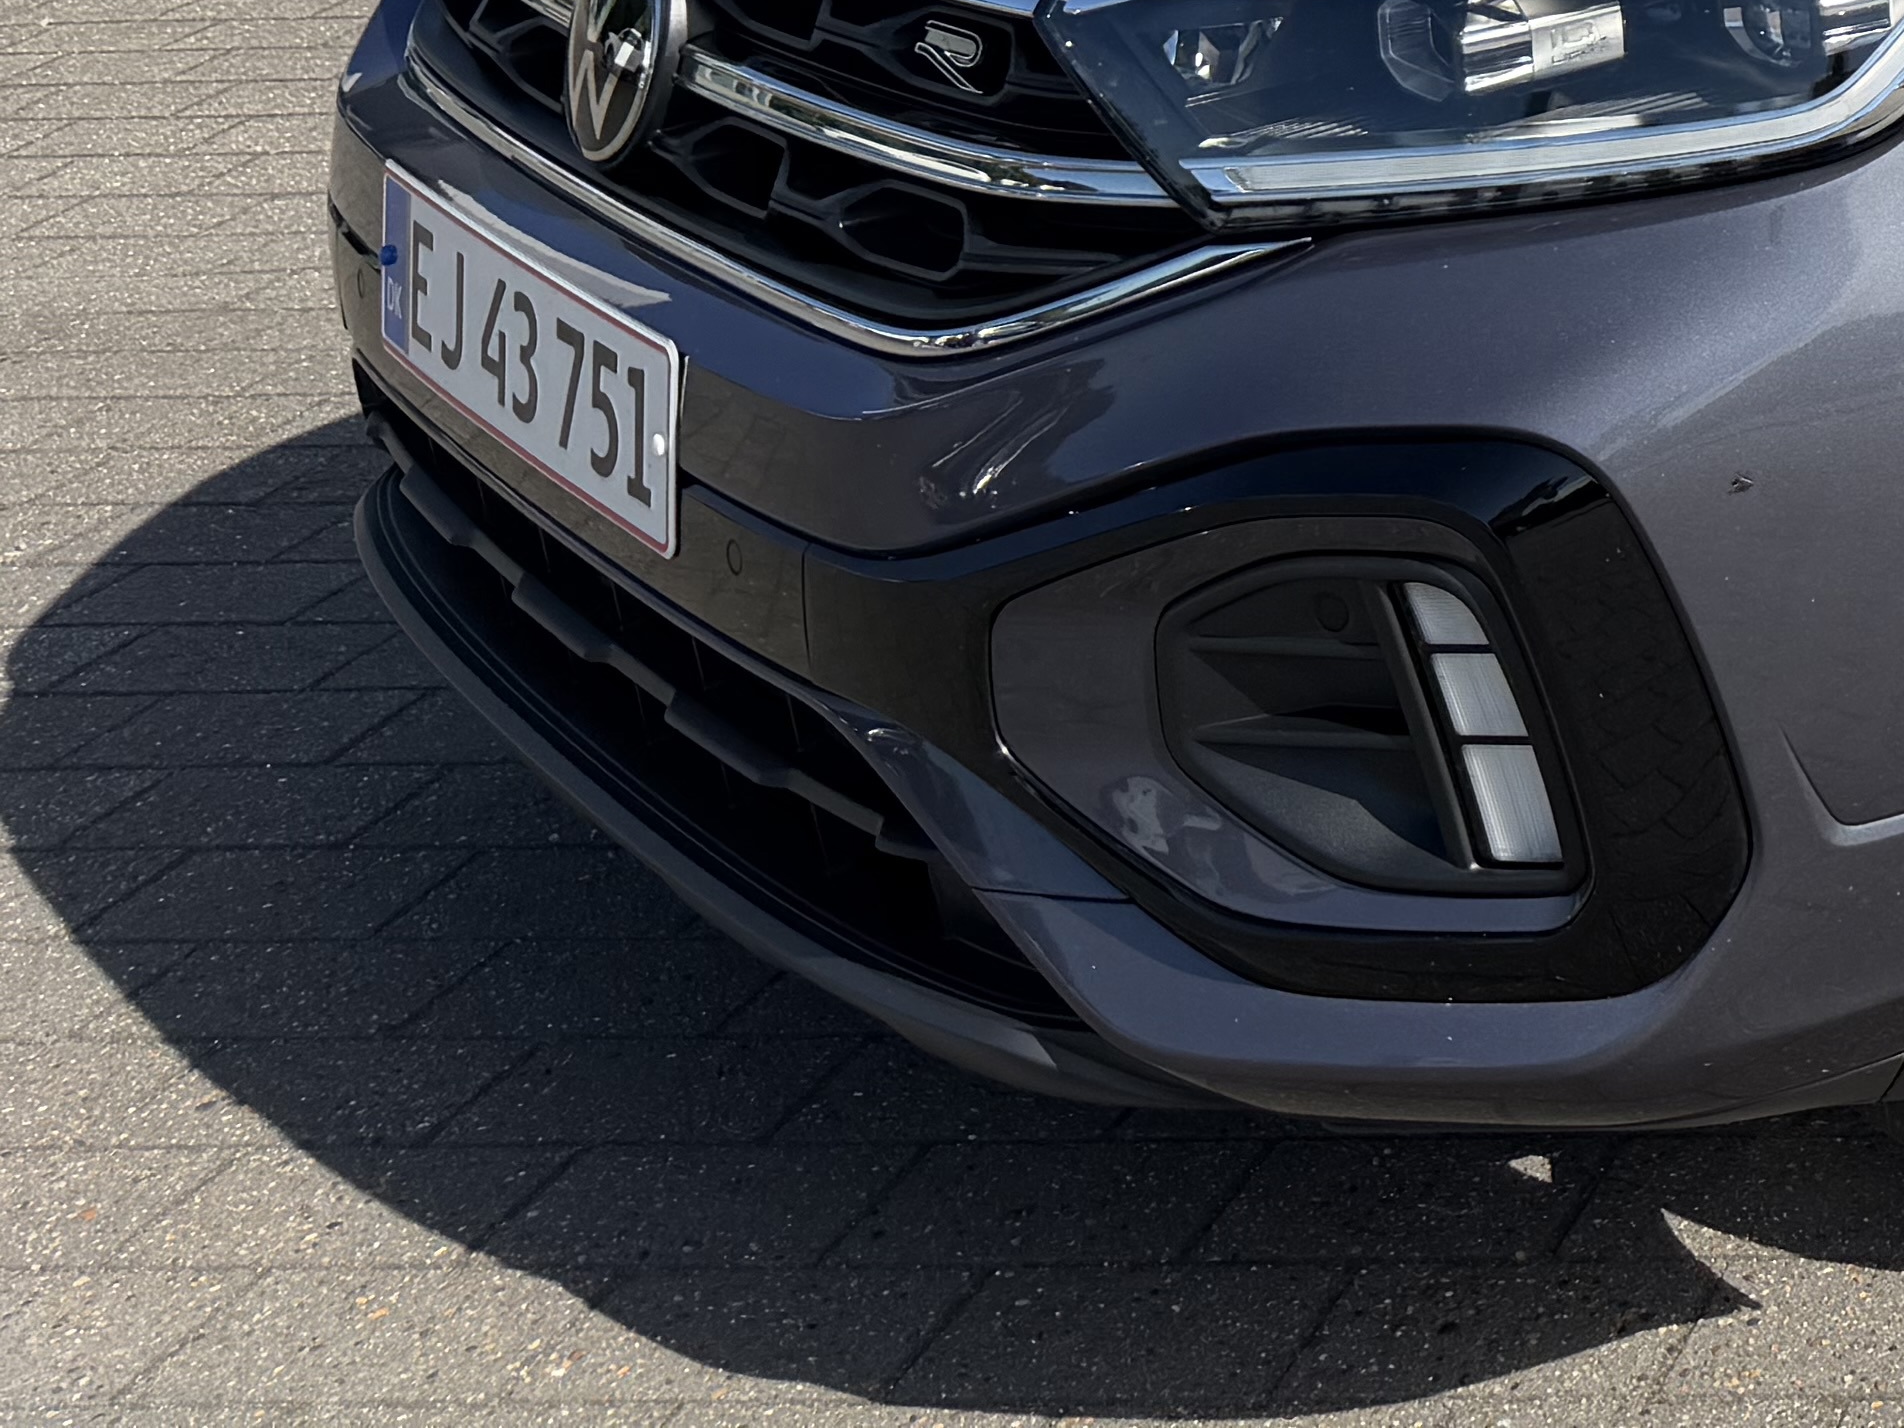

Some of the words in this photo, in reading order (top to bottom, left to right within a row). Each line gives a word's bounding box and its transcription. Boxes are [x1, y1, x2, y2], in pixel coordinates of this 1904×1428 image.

[386, 276, 402, 320] DK
[411, 219, 465, 371] EJ
[480, 277, 539, 425] 43
[555, 316, 653, 509] 751
